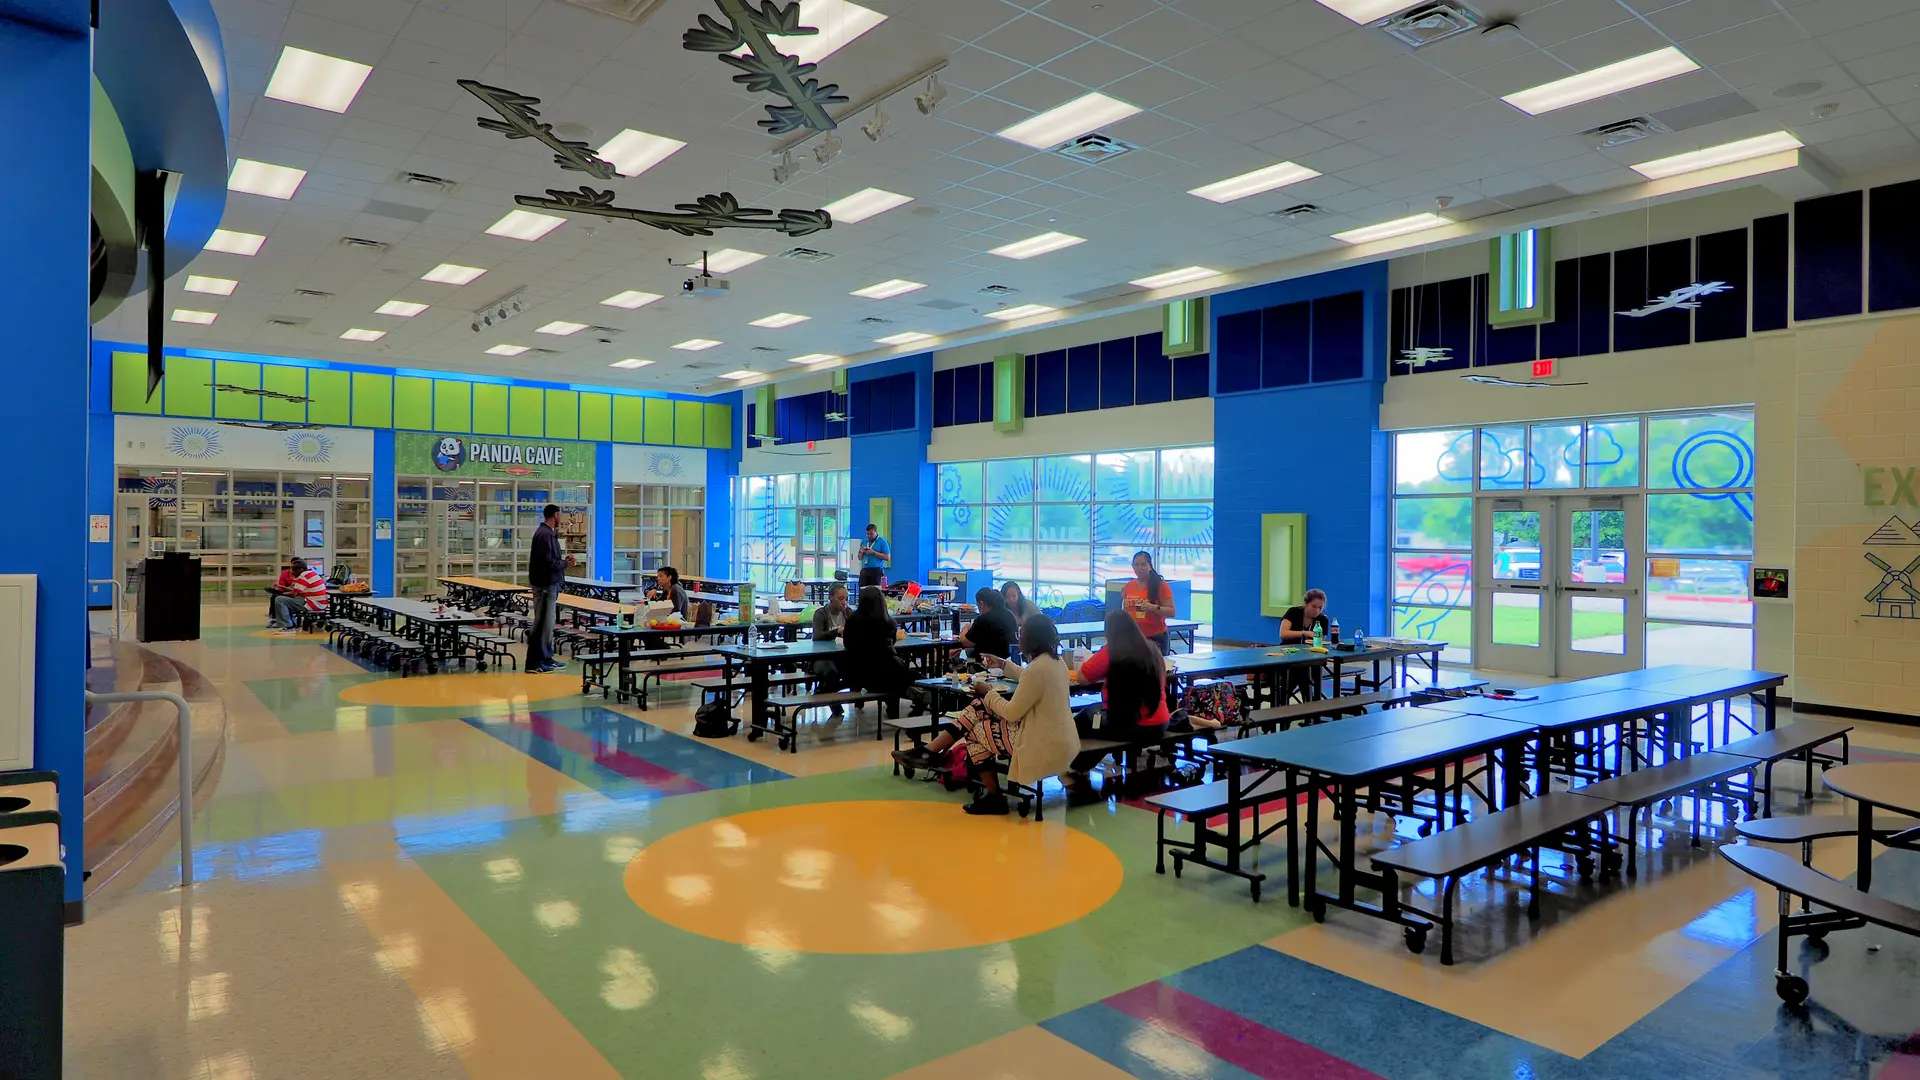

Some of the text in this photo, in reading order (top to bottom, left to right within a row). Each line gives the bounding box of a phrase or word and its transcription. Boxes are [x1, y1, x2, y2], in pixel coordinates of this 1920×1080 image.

[1534, 361, 1553, 376] EXIT
[470, 443, 563, 466] PANDA CAVE
[1864, 466, 1918, 507] EX
[244, 490, 294, 506] ACTIE
